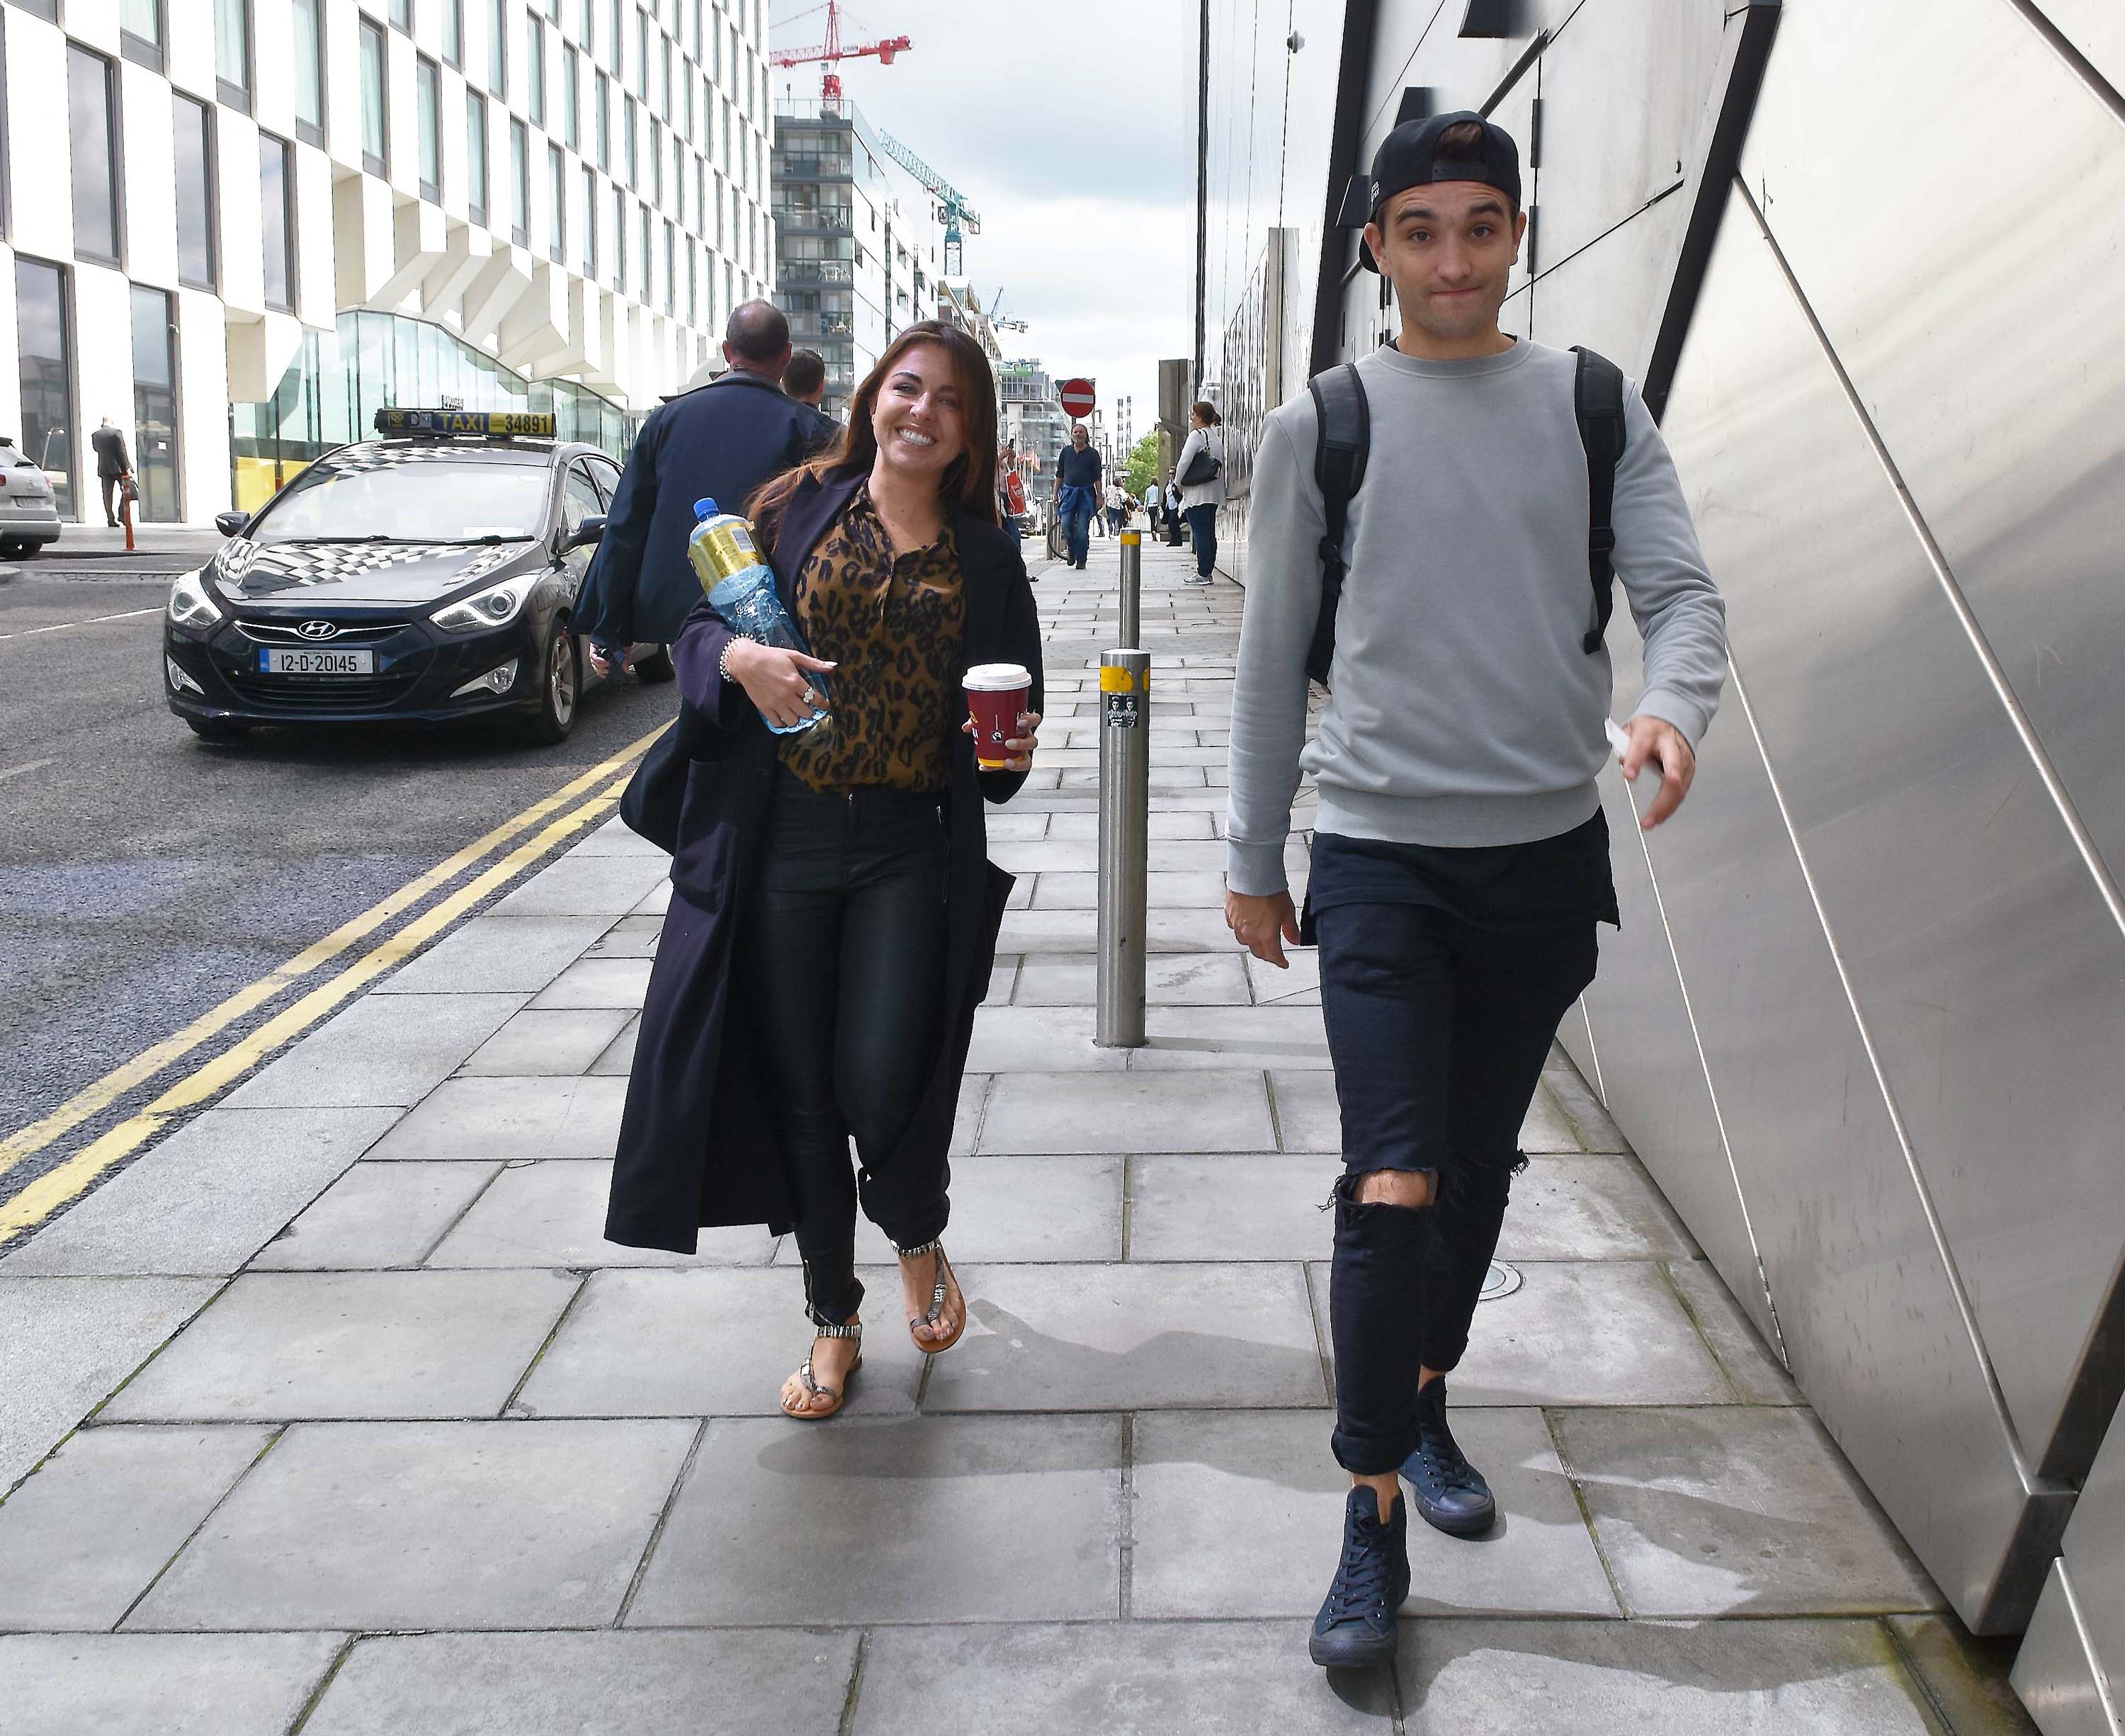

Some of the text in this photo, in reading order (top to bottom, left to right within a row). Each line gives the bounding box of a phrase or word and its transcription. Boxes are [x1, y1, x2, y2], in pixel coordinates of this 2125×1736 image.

[441, 413, 484, 431] TAXI
[505, 414, 548, 432] 34891
[281, 655, 357, 671] 12-D-20145
